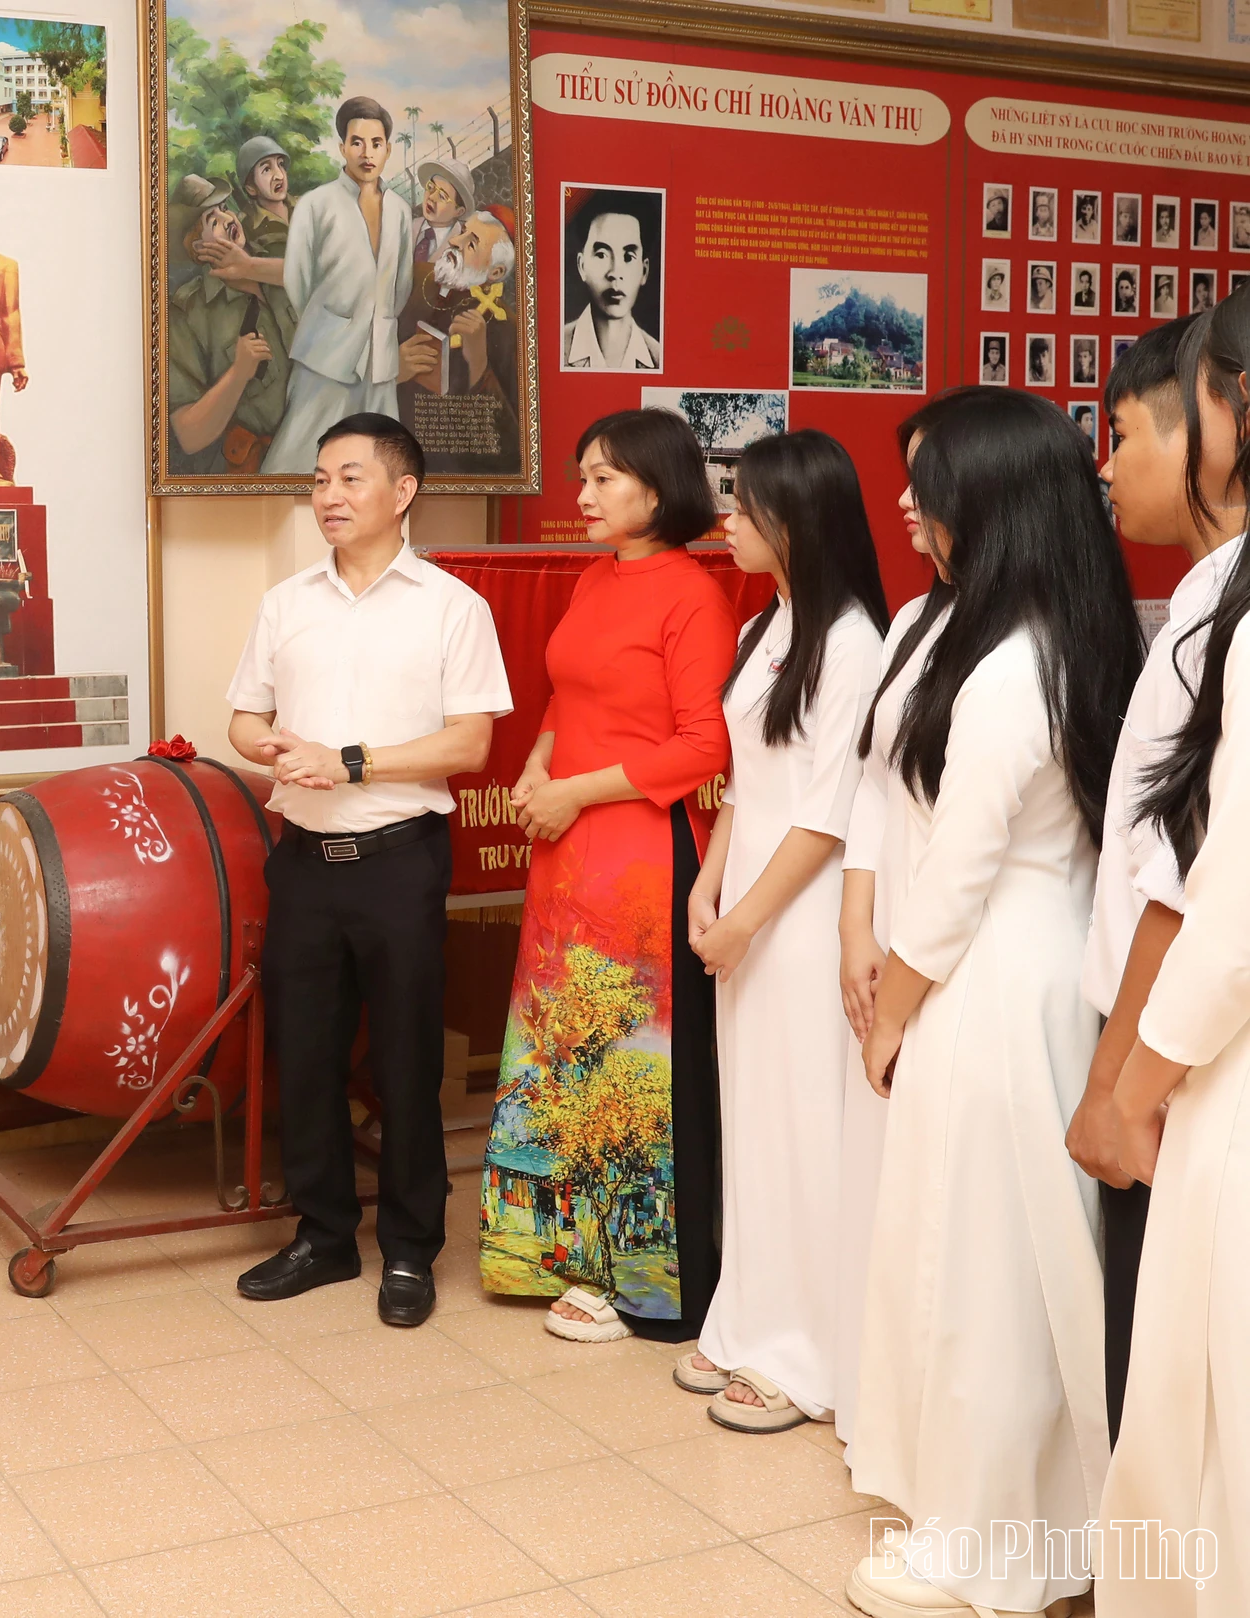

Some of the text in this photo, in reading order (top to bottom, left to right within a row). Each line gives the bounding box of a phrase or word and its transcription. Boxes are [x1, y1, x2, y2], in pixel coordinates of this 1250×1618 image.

[556, 61, 922, 136] TIỂU SỬ ĐỒNG CHÍ HOÀNG VĂN THỤ
[990, 106, 1028, 123] NHỮNG
[1031, 110, 1055, 128] LIỆT
[1075, 114, 1089, 129] LÀ
[1116, 121, 1139, 136] HỌC
[1141, 124, 1164, 137] SINH
[1167, 126, 1209, 142] TRƯỜNG
[1211, 129, 1246, 146] HOÀNG
[1010, 132, 1025, 145] HY
[1027, 134, 1052, 148] SINH
[1055, 137, 1093, 152] TRONG
[1096, 140, 1117, 154] CÁC
[1119, 141, 1148, 158] CUỘC
[1150, 144, 1181, 160] CHIẾN
[1184, 146, 1206, 162] ĐẤU
[458, 773, 726, 828] TRƯỜN NG
